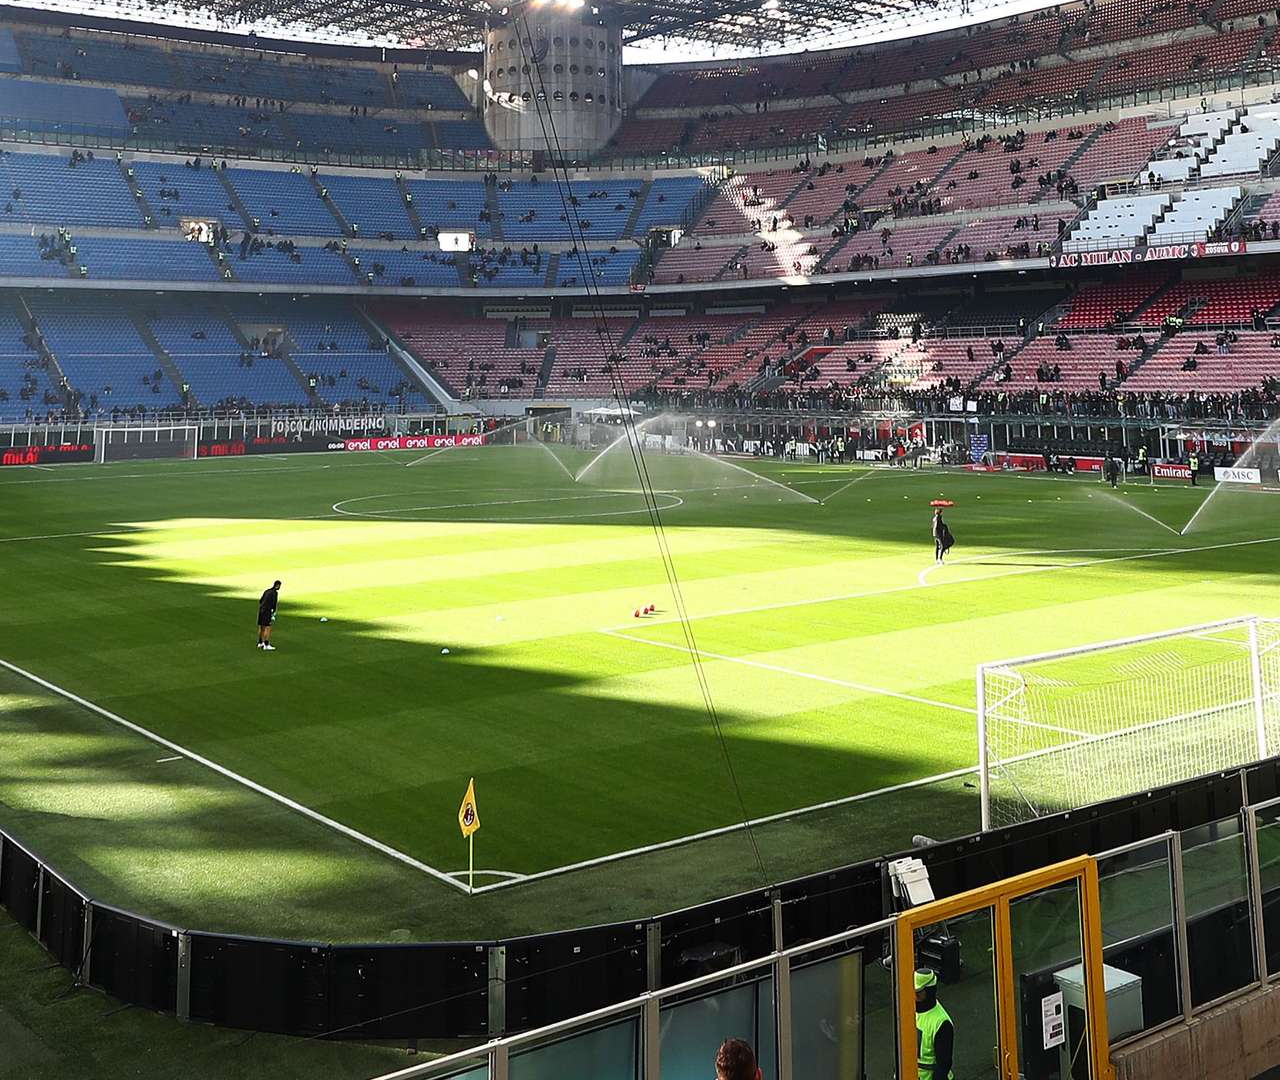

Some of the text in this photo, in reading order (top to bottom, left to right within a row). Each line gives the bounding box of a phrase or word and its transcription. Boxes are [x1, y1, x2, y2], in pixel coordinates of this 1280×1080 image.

[1058, 254, 1078, 268] AC
[1081, 249, 1132, 266] MILAN
[348, 439, 370, 450] enel
[378, 438, 399, 449] enel
[406, 437, 427, 448] enel
[434, 436, 455, 447] enel
[462, 435, 482, 446] enel
[1232, 471, 1253, 481] MSC
